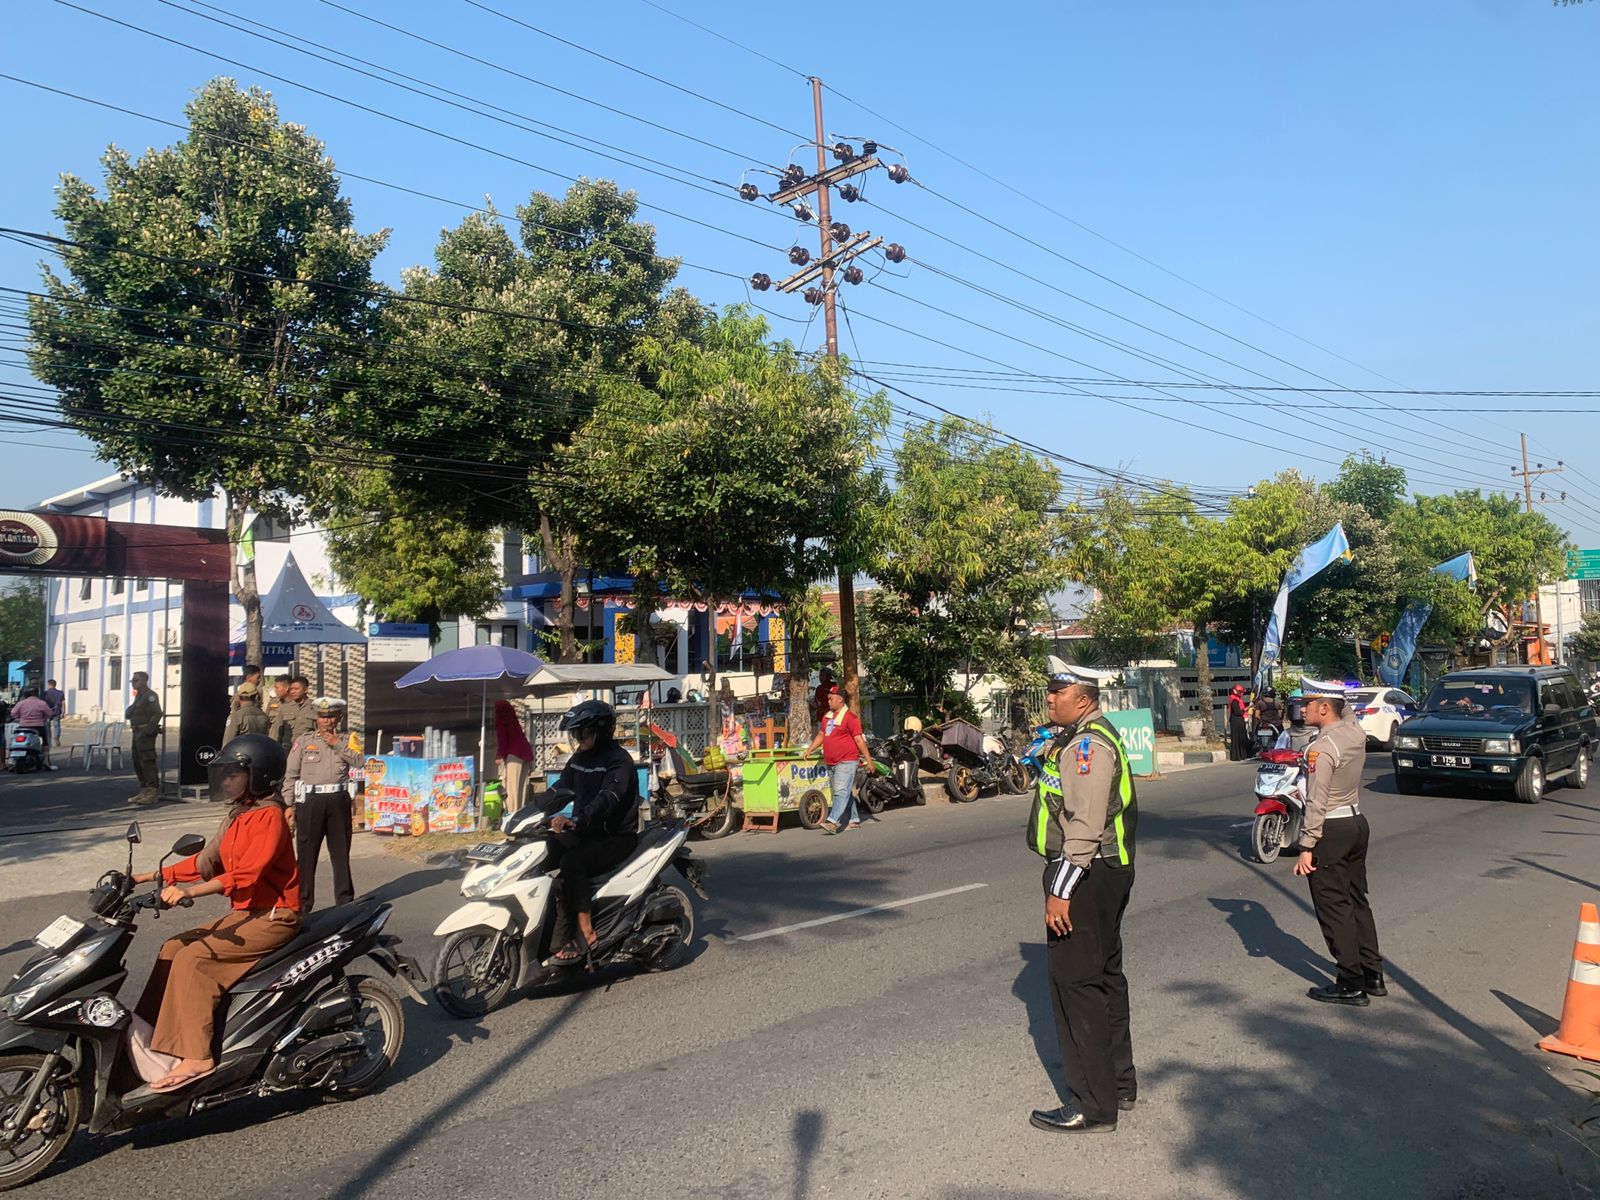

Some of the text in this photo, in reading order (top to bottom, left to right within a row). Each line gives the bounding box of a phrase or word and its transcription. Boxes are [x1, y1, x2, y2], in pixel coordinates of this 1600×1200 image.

[1119, 725, 1153, 752] RKIR
[199, 751, 214, 760] 18+
[1432, 755, 1437, 763] S
[285, 941, 341, 978] STREET
[47, 1000, 82, 1017] HONDA
